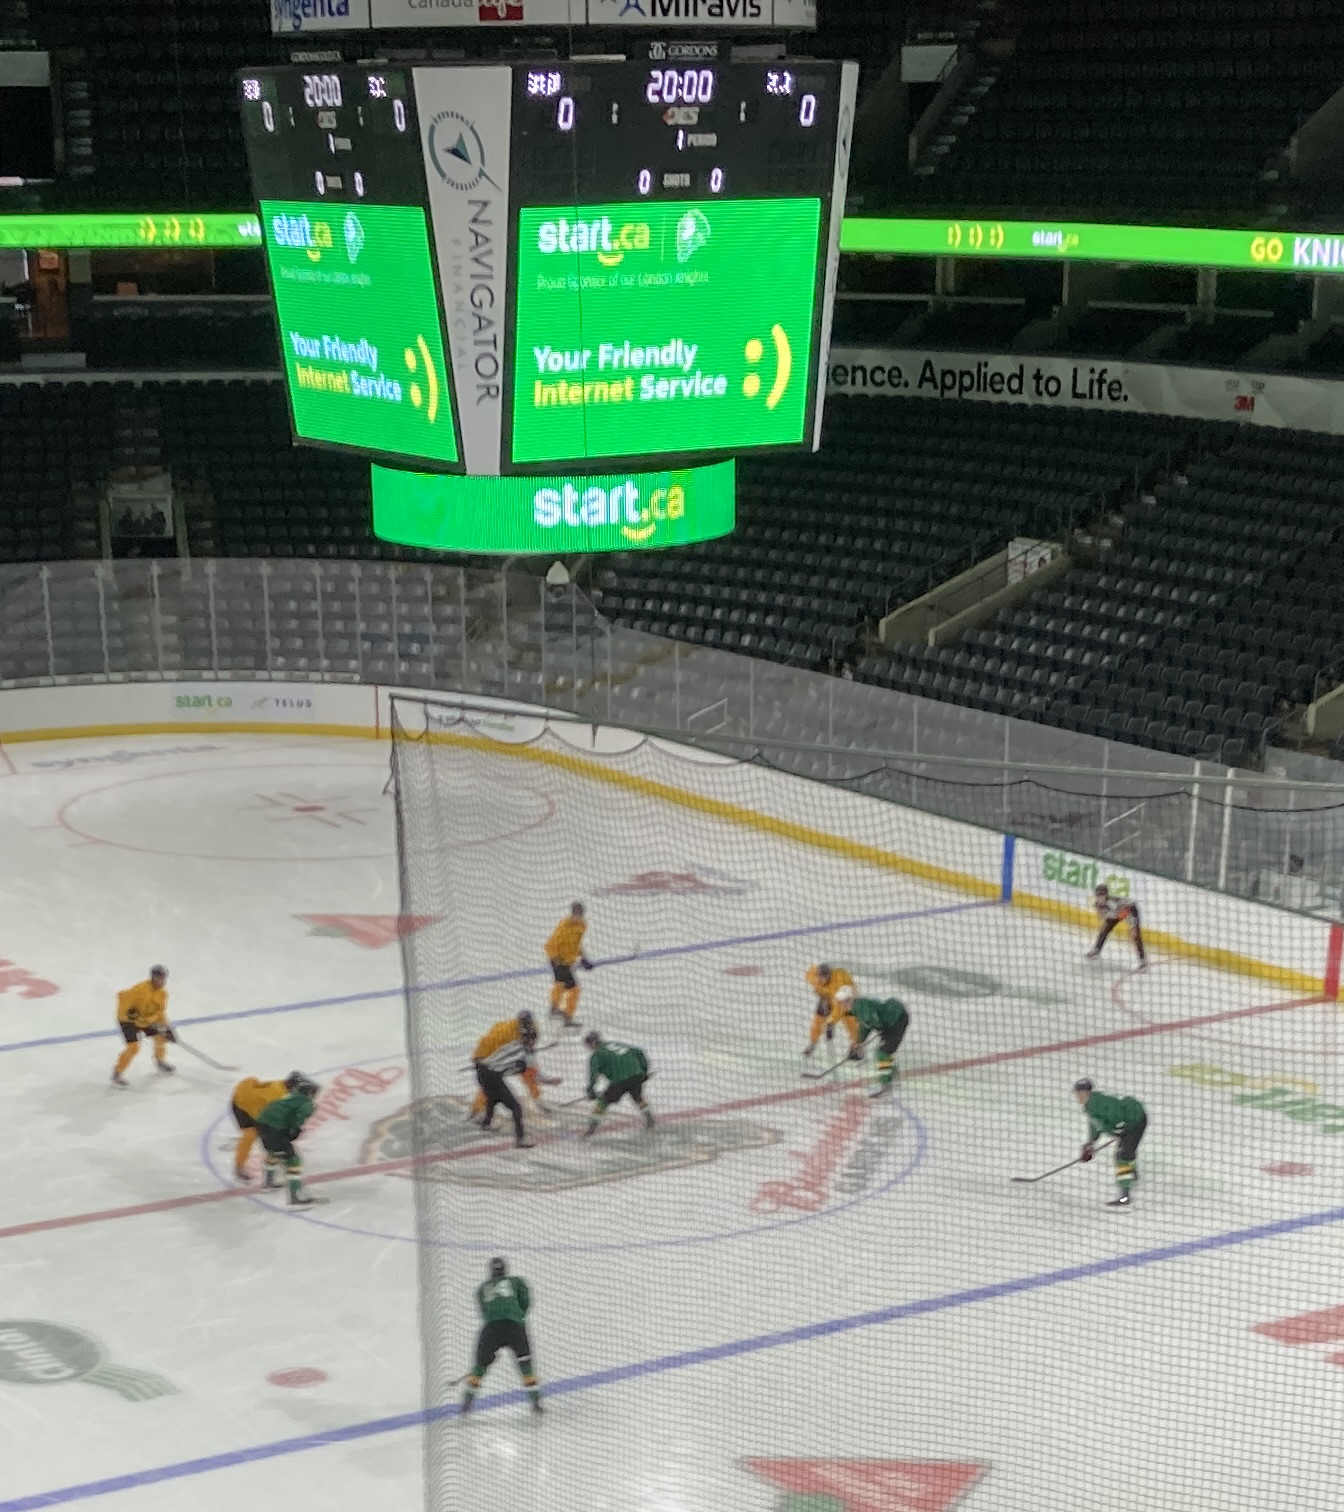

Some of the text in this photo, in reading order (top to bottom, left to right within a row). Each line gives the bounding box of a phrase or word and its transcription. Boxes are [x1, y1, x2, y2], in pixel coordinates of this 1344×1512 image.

[647, 69, 713, 103] 20:00
[557, 97, 575, 130] 0
[799, 94, 816, 127] 0
[638, 168, 651, 195] 0
[710, 167, 724, 194] 0
[537, 215, 650, 254] start.ca
[1250, 236, 1283, 263] GO
[467, 200, 500, 406] NAVIGATOR
[289, 331, 379, 373] Your Friendly
[533, 338, 699, 374] Your Friendly
[295, 361, 402, 403] Internet Service
[533, 371, 728, 408] Internet Service
[917, 361, 1025, 399] Applied
[1032, 366, 1062, 396] to
[1072, 366, 1129, 402] Life.
[533, 480, 685, 528] start.ca
